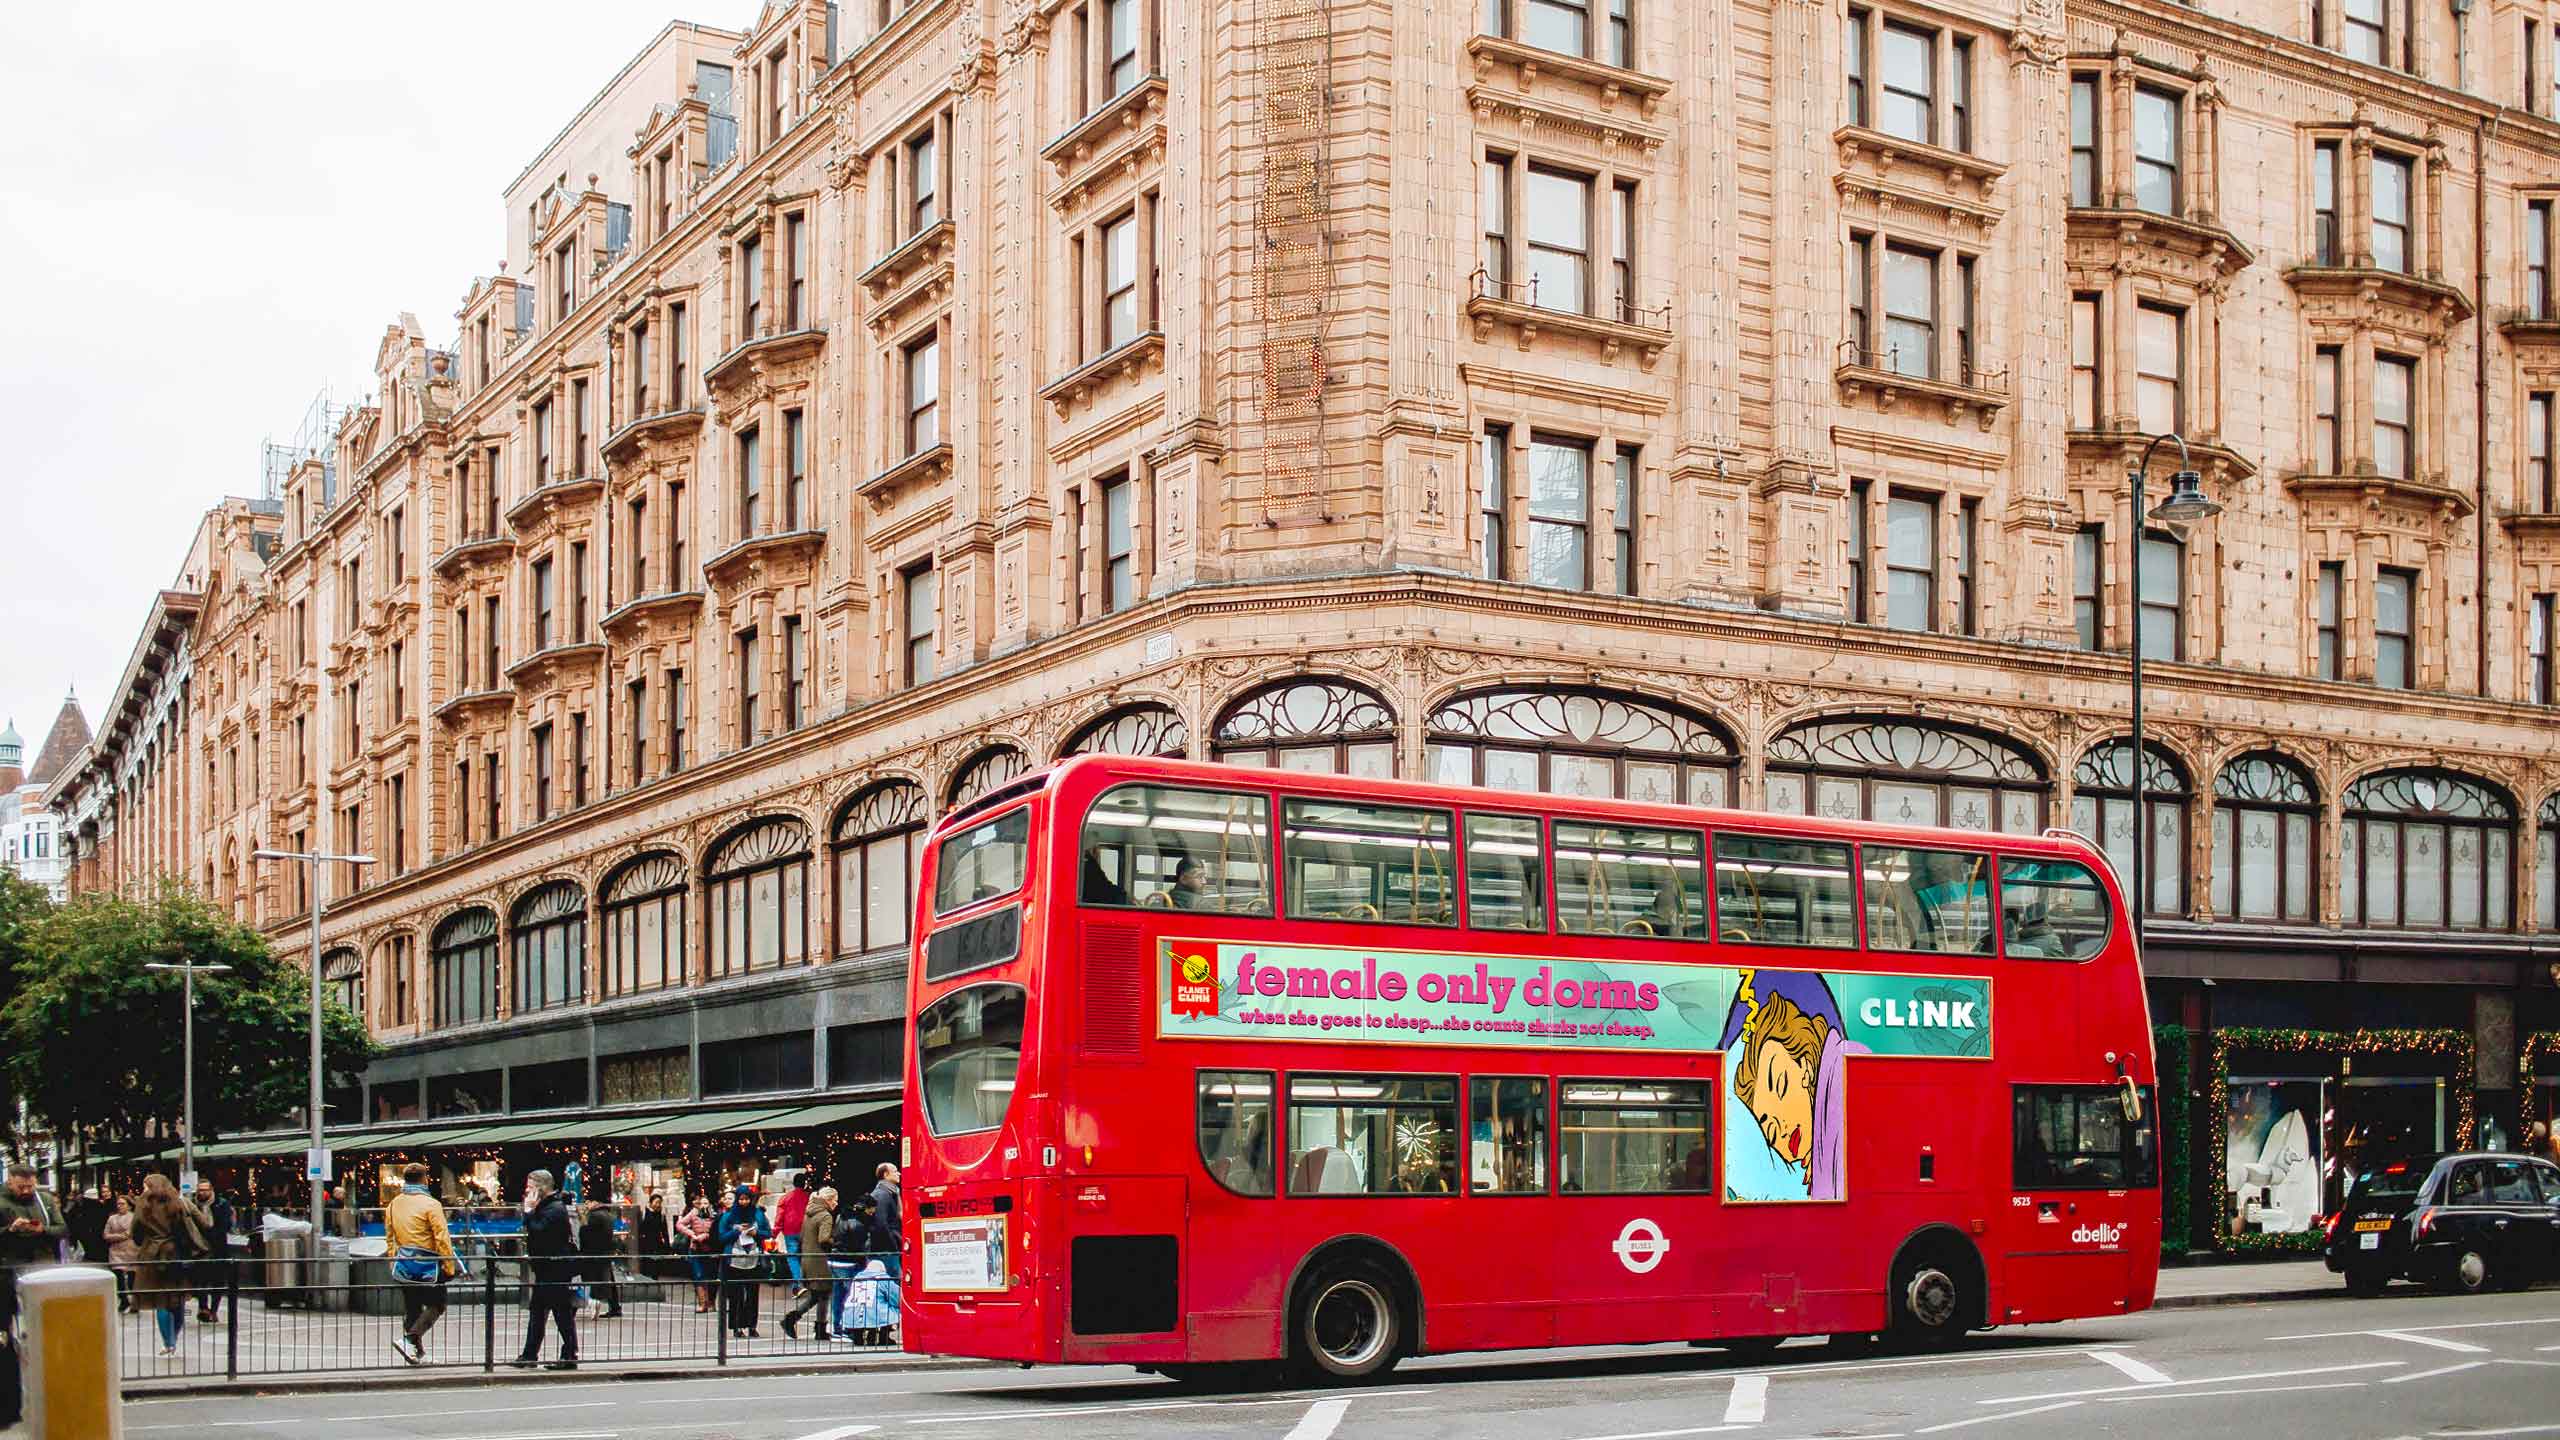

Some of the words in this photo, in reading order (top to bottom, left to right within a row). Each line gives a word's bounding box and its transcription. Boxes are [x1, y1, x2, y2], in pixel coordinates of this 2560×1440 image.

[1178, 986, 1210, 994] PLANET
[1237, 952, 1408, 1001] female
[1417, 963, 1516, 1014] only
[1523, 966, 1660, 1012] dorms
[1240, 1008, 1286, 1025] when
[1289, 1009, 1318, 1026] she
[1321, 1013, 1362, 1030] goes
[1366, 1013, 1382, 1028] to
[1473, 1018, 1526, 1033] counts
[1580, 1021, 1604, 1036] not
[1606, 1020, 1656, 1040] sheep.
[2012, 1196, 2031, 1207] 9523
[2071, 1223, 2120, 1243] abellio
